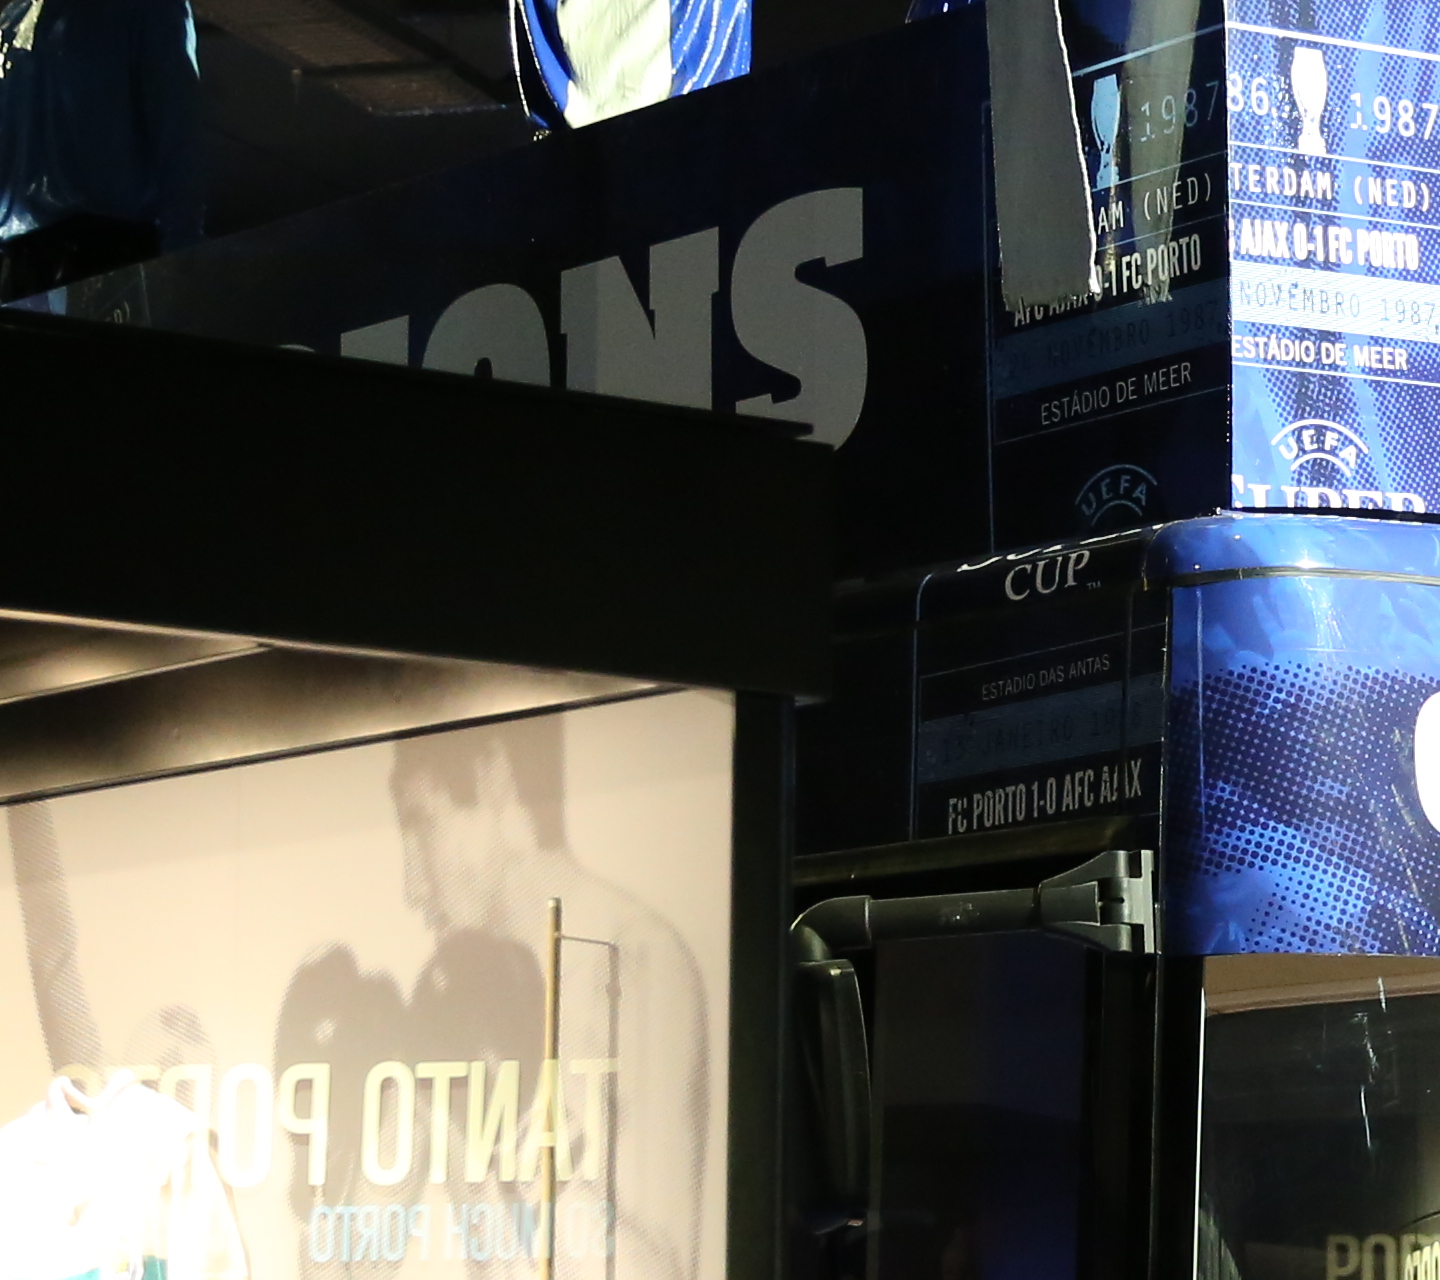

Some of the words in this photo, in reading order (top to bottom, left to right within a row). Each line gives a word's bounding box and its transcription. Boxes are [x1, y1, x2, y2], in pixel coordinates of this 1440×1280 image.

[1139, 82, 1221, 144] 1987
[1350, 92, 1439, 140] 1987
[1142, 172, 1212, 220] (NED)
[1353, 170, 1431, 213] (NED)
[1122, 254, 1142, 291] FC
[1146, 234, 1202, 287] PORTO
[1240, 218, 1289, 259] AJAX
[1327, 227, 1353, 266] FC
[1357, 231, 1420, 271] PORTO
[1240, 278, 1360, 318] NOVEMBRO
[1380, 294, 1437, 326] 1987
[1231, 332, 1316, 364] ESTÁDIO
[1320, 344, 1346, 366] DE
[1353, 345, 1409, 371] MEER
[1041, 383, 1111, 426] ESTÁDIO
[1115, 380, 1138, 407] DE
[1143, 361, 1193, 397] MEER
[1274, 427, 1359, 471] UEFA
[1081, 476, 1149, 517] UEFA
[1004, 550, 1092, 602] CUP
[1040, 666, 1065, 687] DAS
[1068, 653, 1111, 677] ANTAS
[948, 797, 968, 836] FC
[972, 783, 1027, 830] PORTO
[1031, 776, 1057, 819] 1-0
[1062, 768, 1095, 813] AFC
